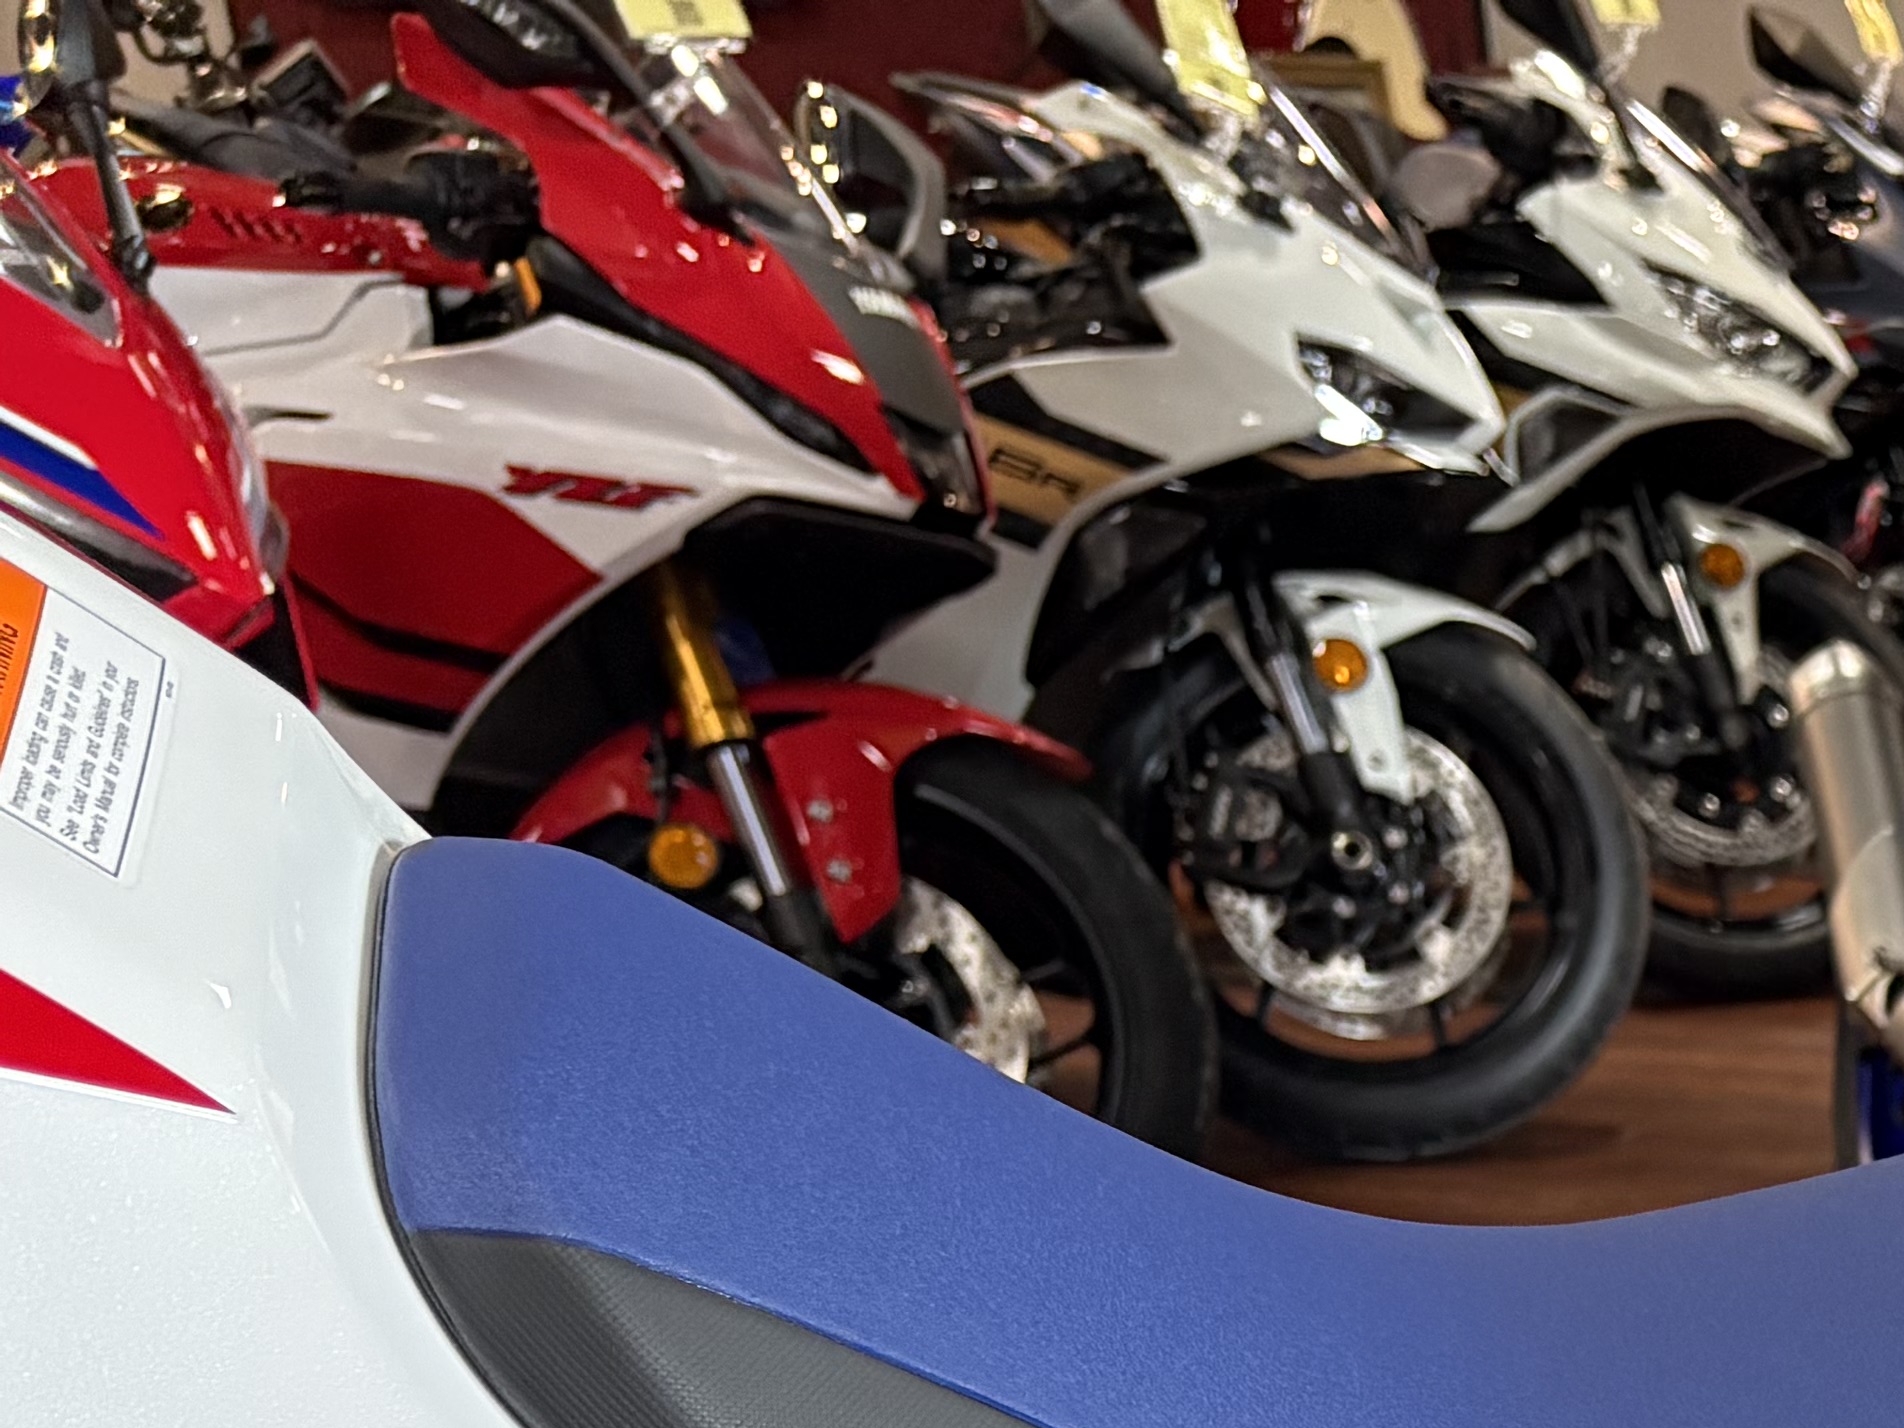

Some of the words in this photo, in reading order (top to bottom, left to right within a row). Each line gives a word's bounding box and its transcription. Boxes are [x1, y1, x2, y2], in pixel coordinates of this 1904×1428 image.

[104, 762, 119, 776] for
[36, 804, 51, 826] you
[46, 765, 61, 779] be
[60, 820, 79, 840] See
[87, 737, 101, 758] and
[95, 776, 116, 812] Manual
[83, 815, 107, 853] Owner's
